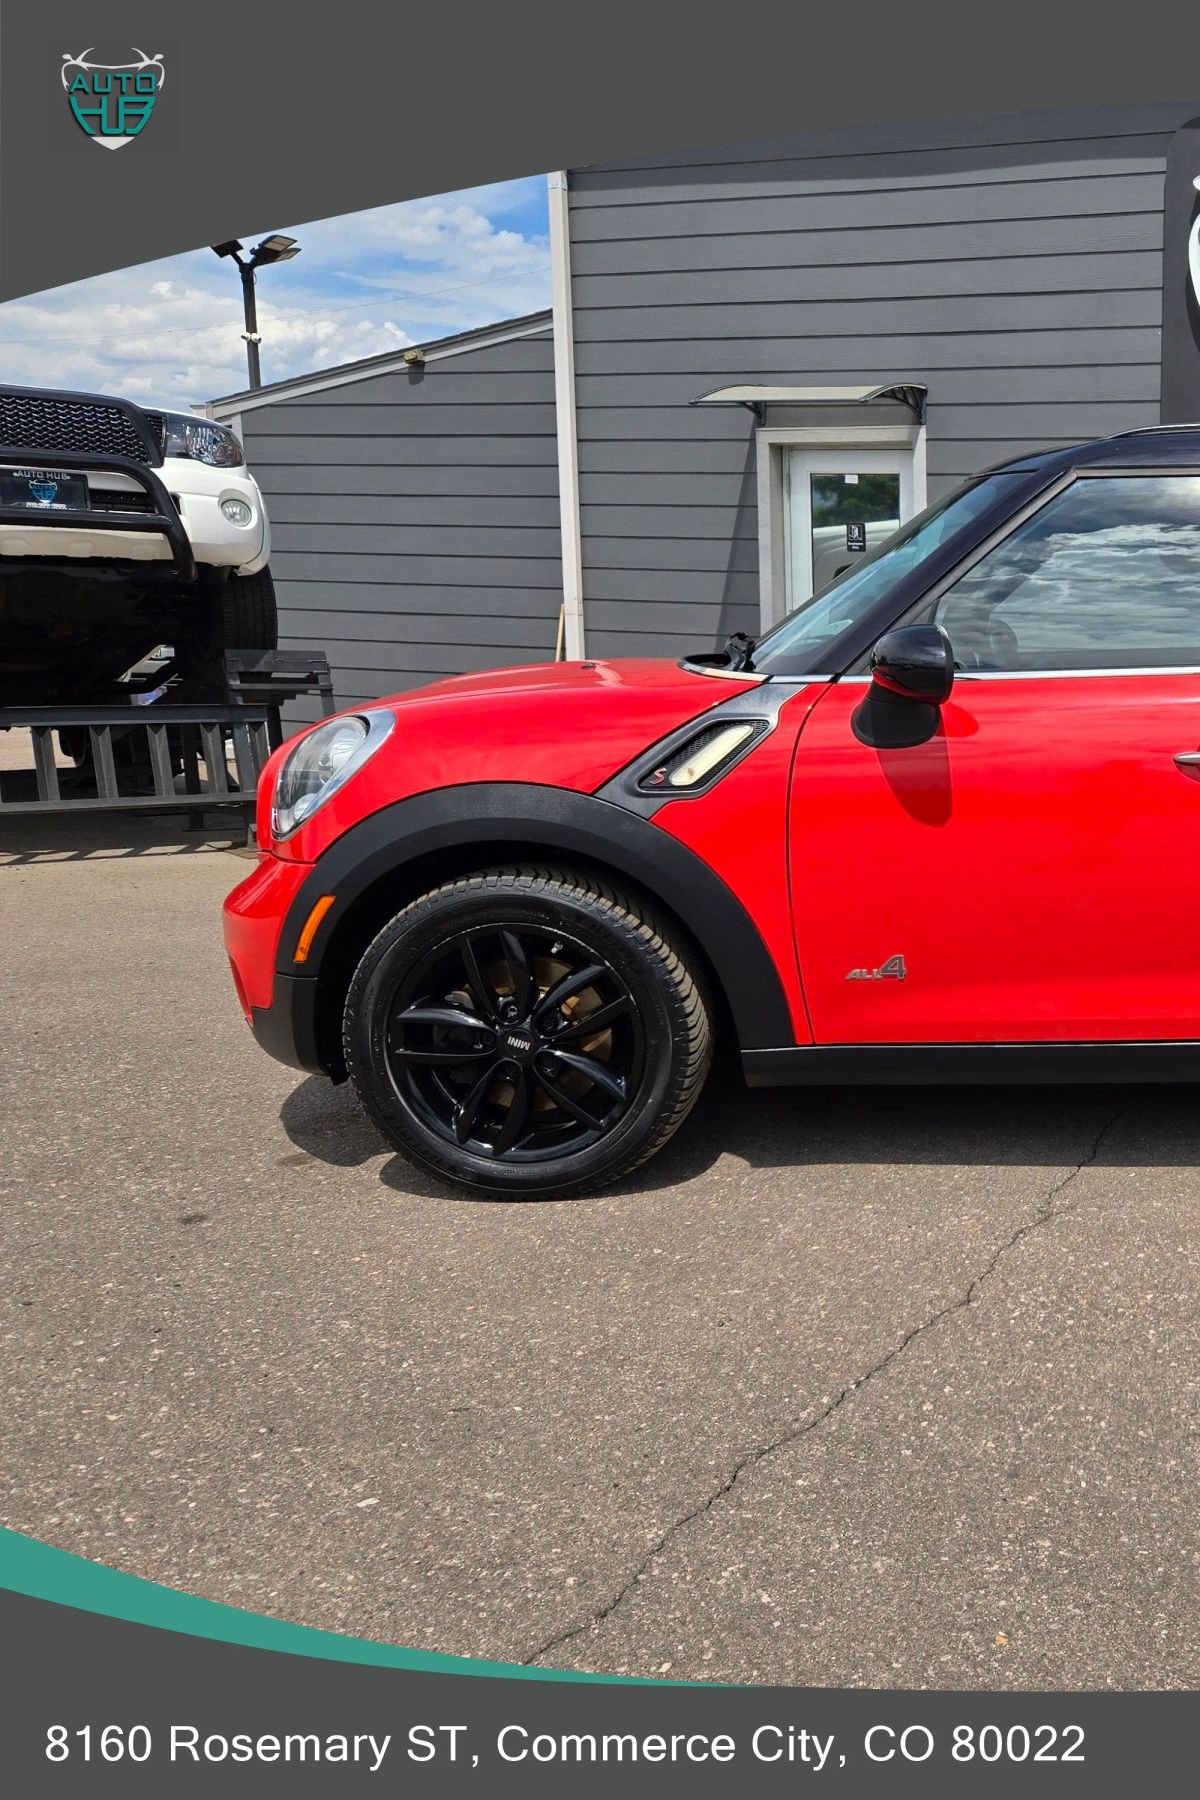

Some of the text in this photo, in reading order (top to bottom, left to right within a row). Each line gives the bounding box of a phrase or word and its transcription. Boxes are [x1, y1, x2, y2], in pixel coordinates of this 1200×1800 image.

[17, 470, 67, 480] AUTO HUB
[650, 767, 667, 784] S
[507, 1035, 531, 1051] MINI
